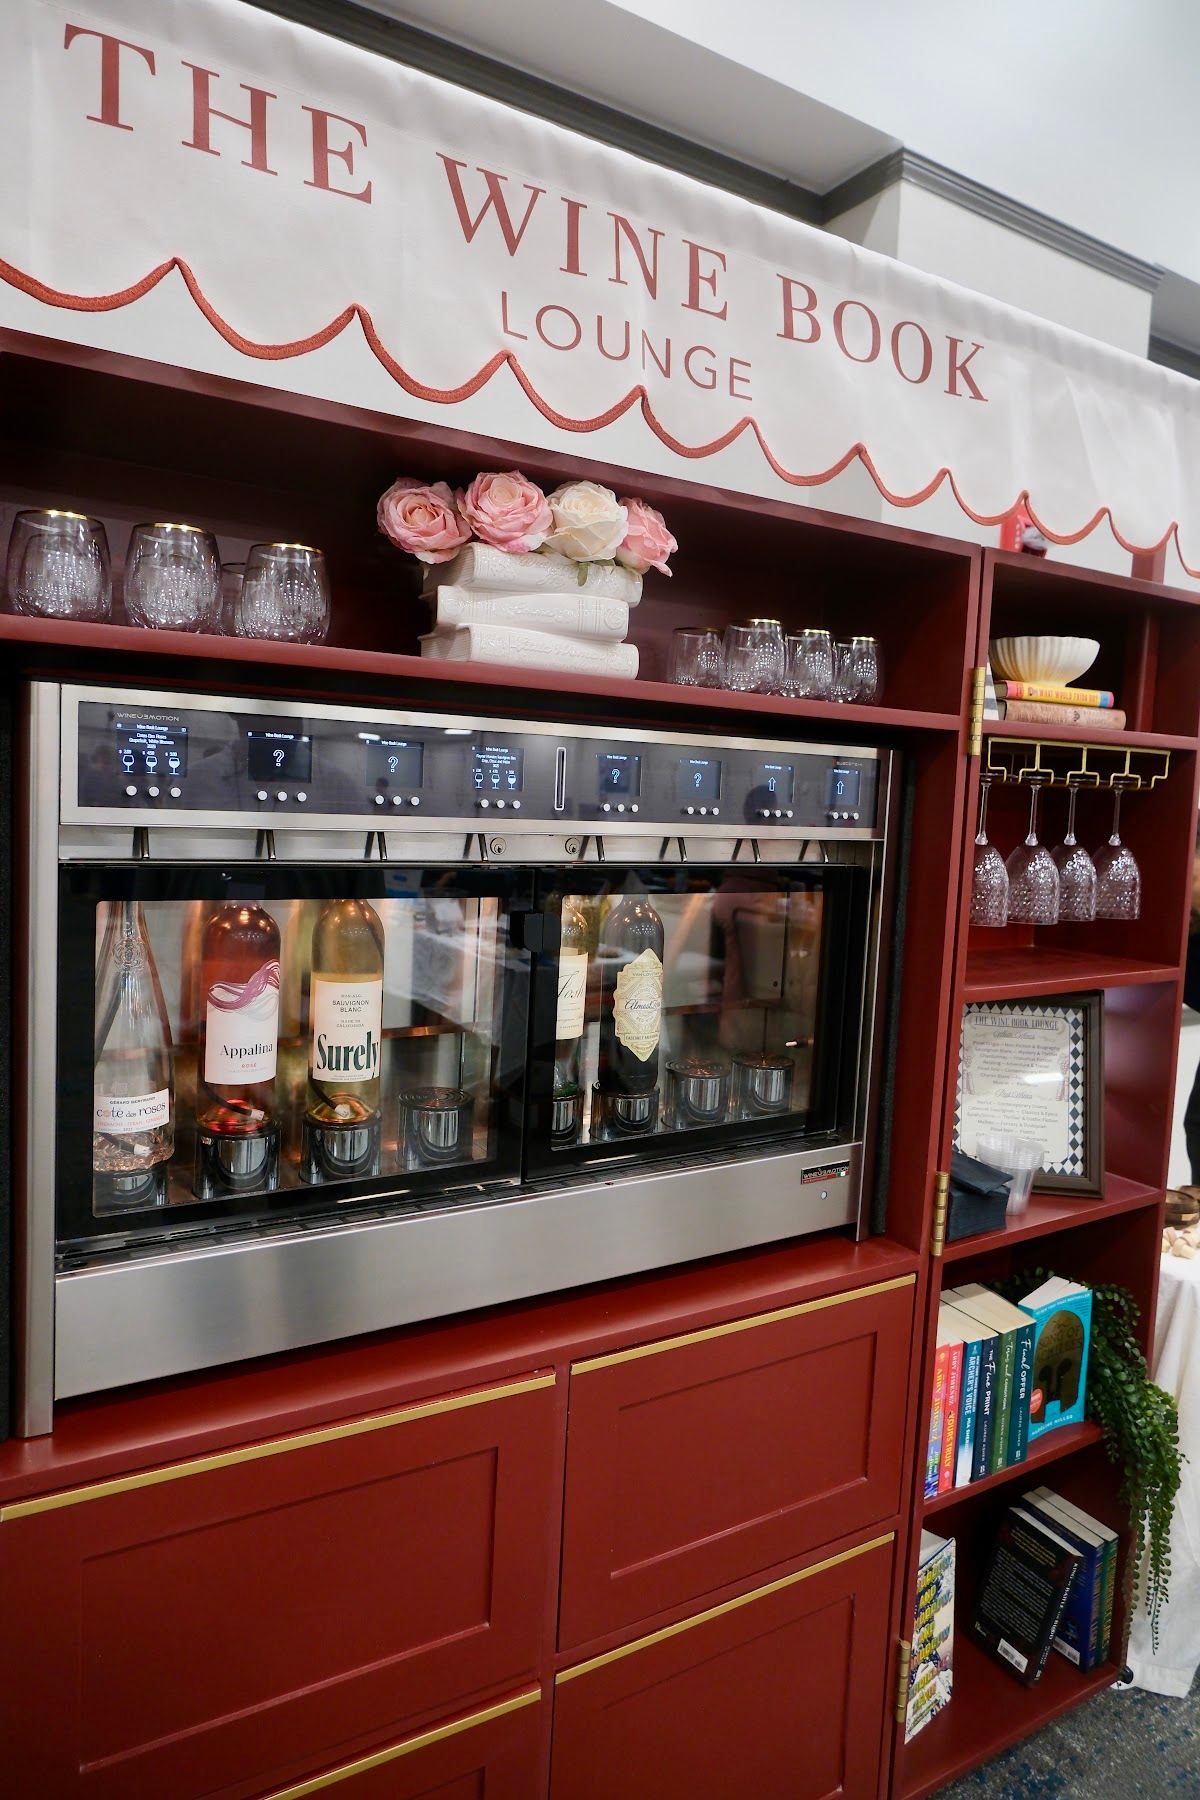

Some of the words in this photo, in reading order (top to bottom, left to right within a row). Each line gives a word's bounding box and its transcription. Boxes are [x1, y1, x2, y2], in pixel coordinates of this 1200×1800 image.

[64, 23, 372, 204] THE
[436, 151, 728, 321] WINE
[776, 273, 988, 402] BOOK
[501, 291, 753, 401] LOUNGE
[990, 1016, 1008, 1026] WINE
[1011, 1018, 1029, 1027] BOOK
[1031, 1019, 1058, 1029] LOUNGE
[220, 1043, 273, 1059] Appalina
[316, 1030, 379, 1080] Surely
[139, 1102, 166, 1116] roses
[950, 1349, 959, 1370] ABBY
[1018, 1337, 1032, 1370] Final
[933, 1367, 945, 1396] ABBY
[947, 1370, 957, 1406] JIMENEZ
[966, 1355, 976, 1394] ARCHER'S
[982, 1360, 996, 1389] Fine
[1018, 1369, 1027, 1400] OFFER
[963, 1392, 974, 1416] VOICE
[982, 1389, 991, 1416] PRINT
[944, 1413, 955, 1442] YOURS
[943, 1441, 953, 1468] TRULY
